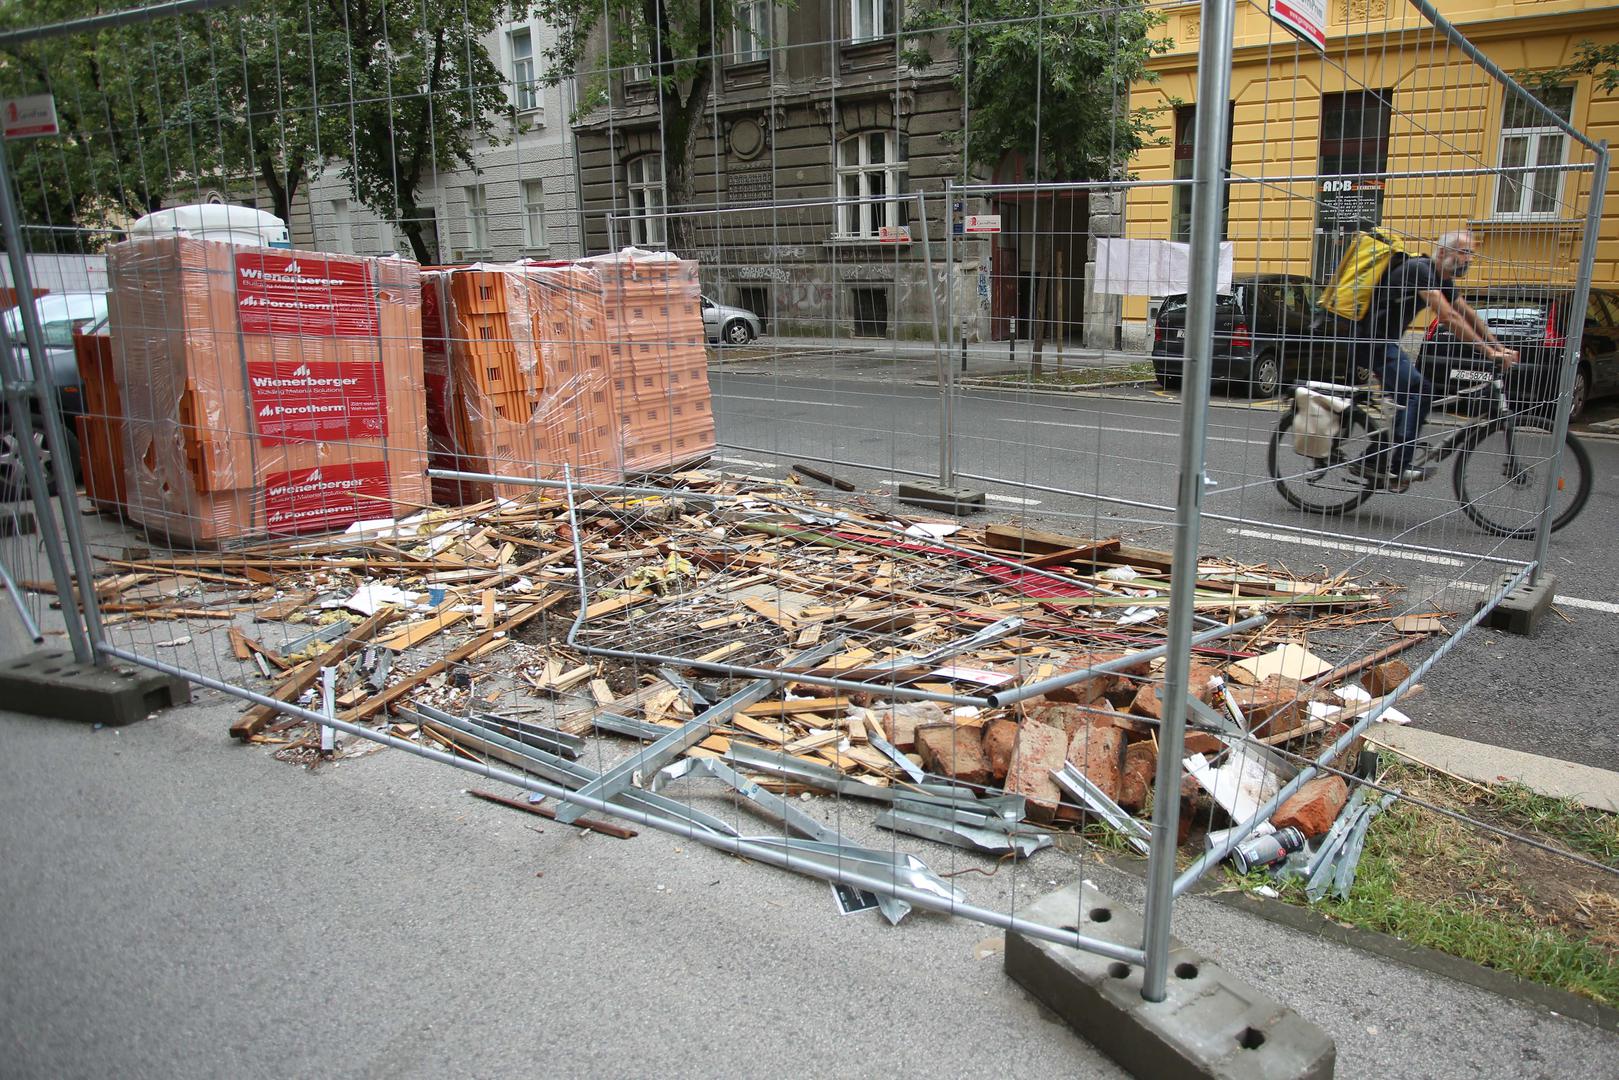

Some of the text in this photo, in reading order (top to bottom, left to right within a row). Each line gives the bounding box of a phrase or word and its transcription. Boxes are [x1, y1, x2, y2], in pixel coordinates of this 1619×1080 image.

[1323, 180, 1352, 191] ADB
[240, 268, 344, 286] Wienerberger
[260, 298, 335, 310] Porotherm
[253, 376, 358, 387] Wienerberger
[275, 404, 346, 415] Porotherm
[269, 478, 364, 497] Wienerberger
[284, 504, 353, 519] Porotherm
